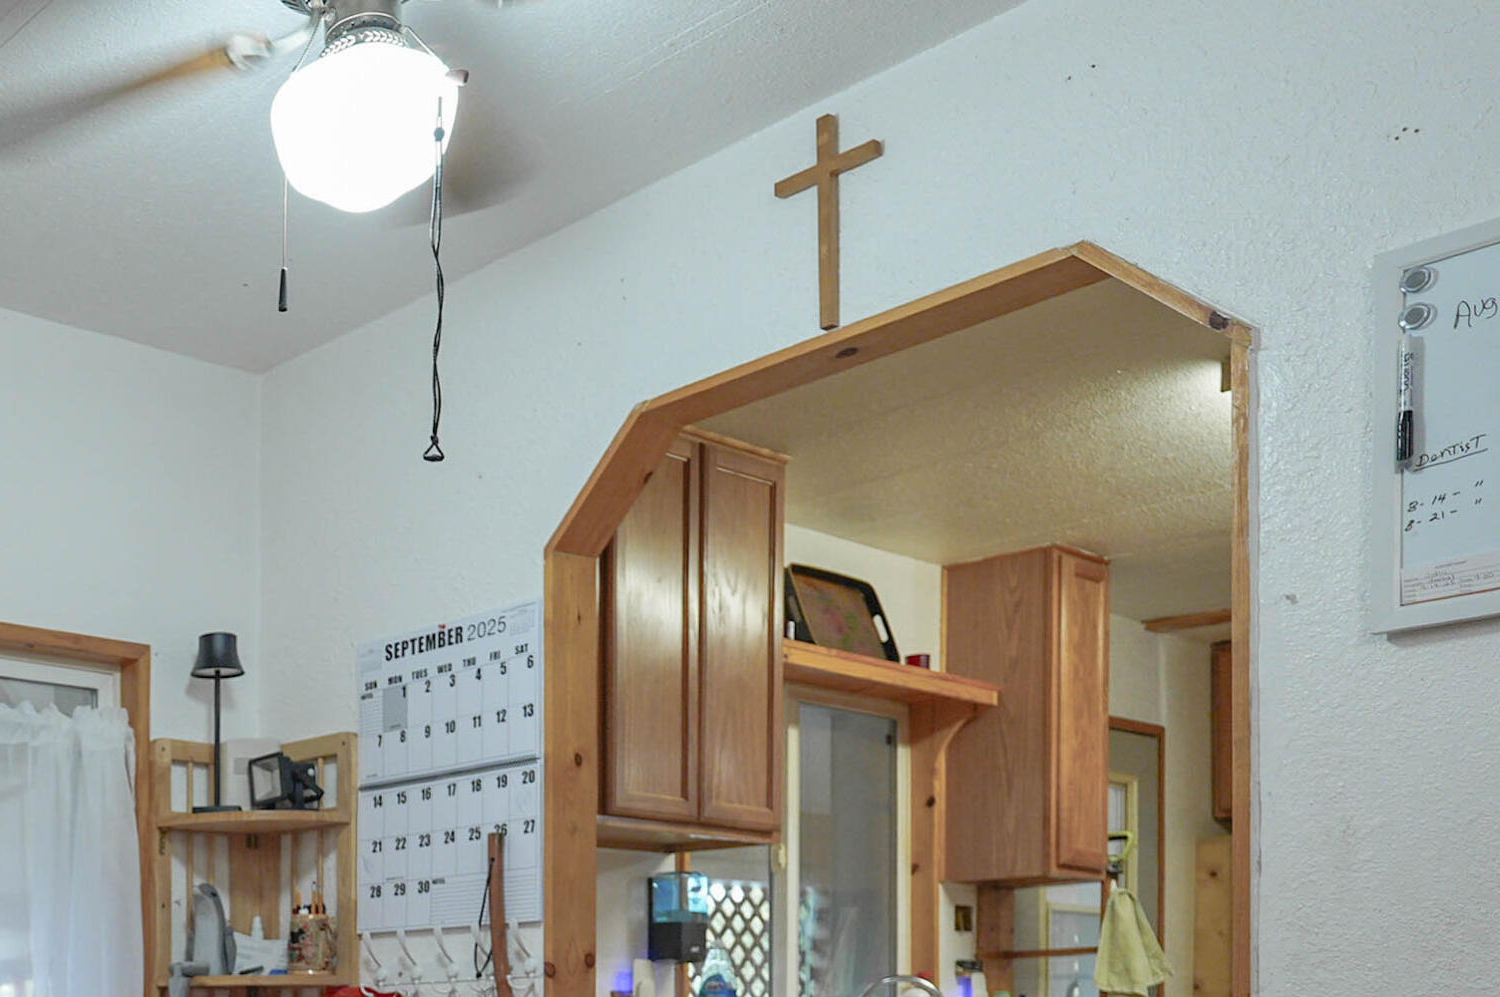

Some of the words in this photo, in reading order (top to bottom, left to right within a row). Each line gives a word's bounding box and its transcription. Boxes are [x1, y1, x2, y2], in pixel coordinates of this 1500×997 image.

[385, 625, 464, 662] SEPTEMBER
[467, 615, 507, 642] 2025
[402, 685, 407, 699] 1
[425, 679, 432, 693] 2
[449, 674, 456, 688] 3
[475, 667, 482, 681] 4
[500, 661, 507, 675] 5
[527, 655, 534, 669] 6
[411, 668, 428, 680] TUES
[515, 643, 528, 655] SAT
[377, 734, 383, 748] 7
[400, 730, 406, 743] 8
[425, 725, 431, 738] 9
[445, 720, 456, 734] 10
[472, 715, 482, 728] 11
[496, 709, 507, 723] 12
[522, 703, 534, 718] 13
[373, 795, 383, 808] 14
[397, 791, 407, 804] 15
[421, 787, 432, 801] 16
[447, 783, 457, 796] 17
[471, 779, 482, 792] 18
[496, 774, 508, 788] 19
[522, 769, 535, 784] 20
[372, 840, 382, 853] 21
[395, 837, 406, 850] 22
[419, 834, 431, 847] 23
[444, 830, 455, 844] 24
[469, 827, 481, 841] 25
[524, 819, 535, 834] 27
[370, 885, 381, 898] 28
[394, 882, 406, 896] 29
[418, 880, 430, 894] 30
